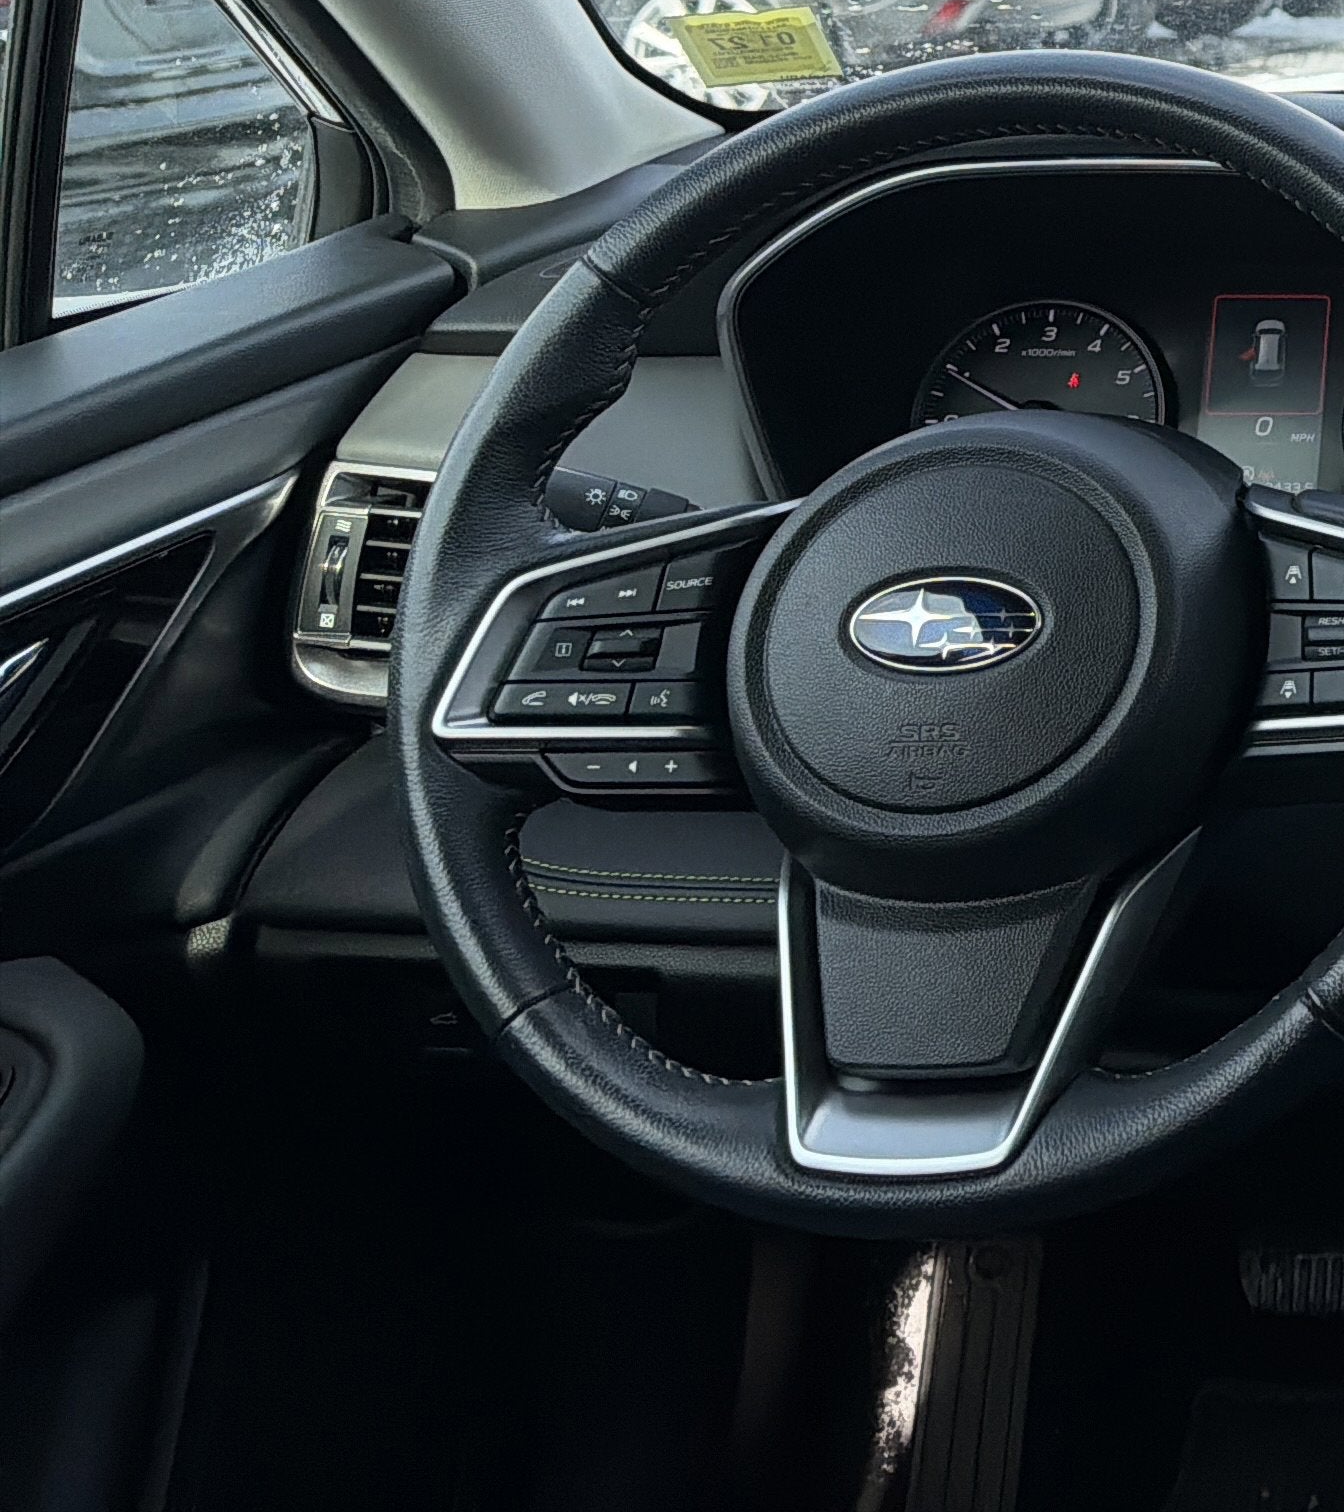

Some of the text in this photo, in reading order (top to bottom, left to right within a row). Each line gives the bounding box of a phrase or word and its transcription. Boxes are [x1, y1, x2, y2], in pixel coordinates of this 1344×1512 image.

[1042, 326, 1057, 341] 3
[995, 339, 1011, 352] 2
[1087, 340, 1102, 353] 4
[1115, 371, 1131, 384] 5
[1255, 416, 1273, 436] 0
[1290, 433, 1315, 442] MPH
[666, 575, 713, 591] SOURCE
[900, 724, 961, 740] SRS
